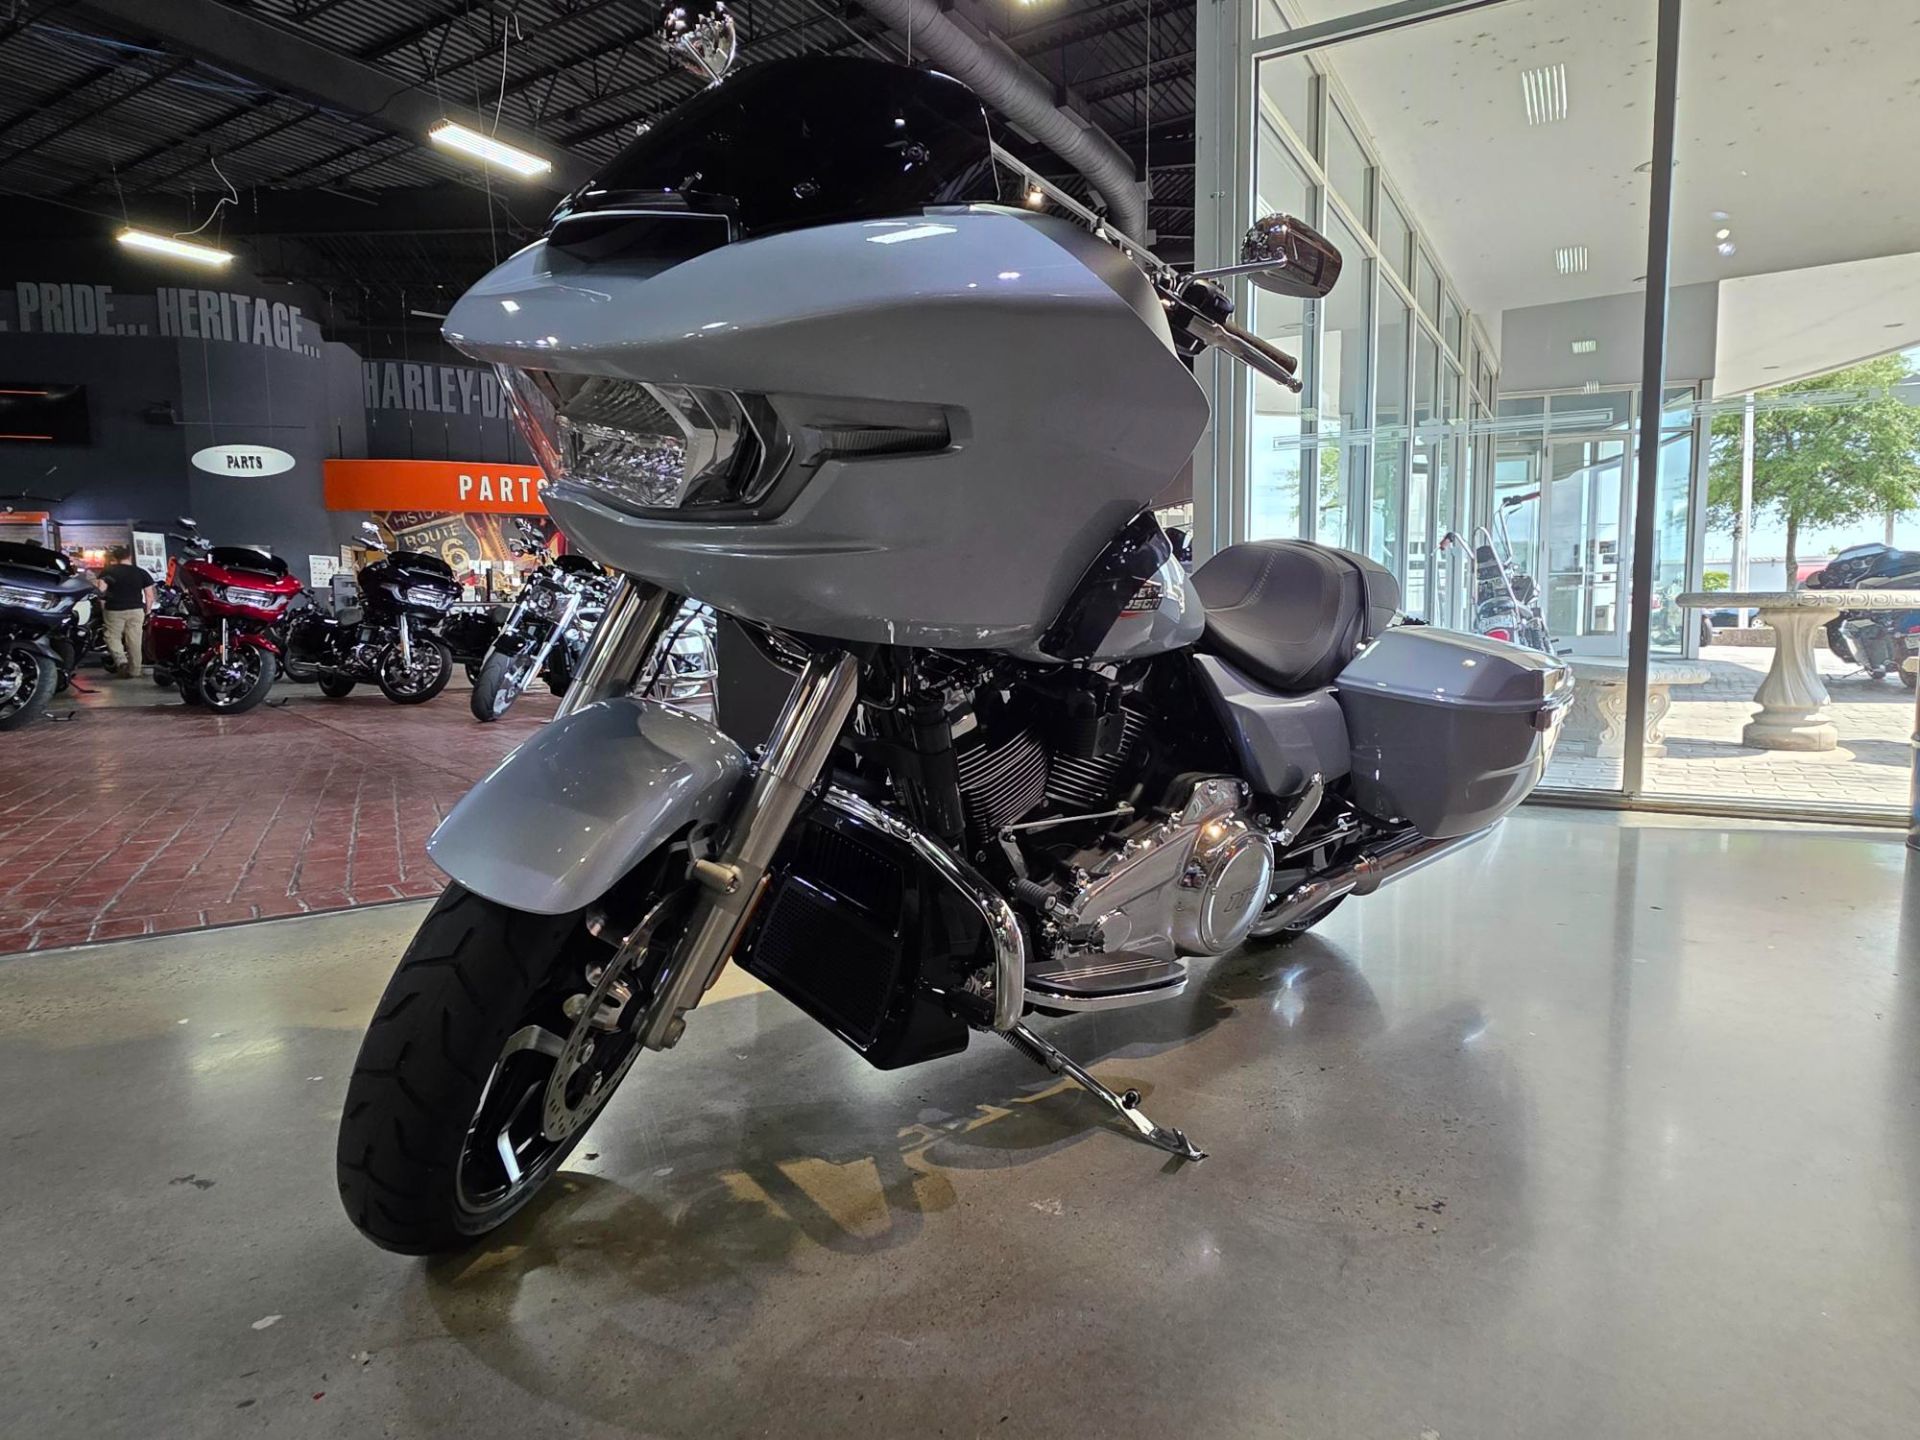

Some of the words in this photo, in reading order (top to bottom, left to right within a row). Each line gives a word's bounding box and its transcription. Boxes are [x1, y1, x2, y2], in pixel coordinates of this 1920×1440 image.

[16, 281, 149, 337] PRIDE...
[156, 286, 322, 359] HERITAGE...
[226, 455, 263, 470] PARTS
[403, 523, 460, 547] ROUTE
